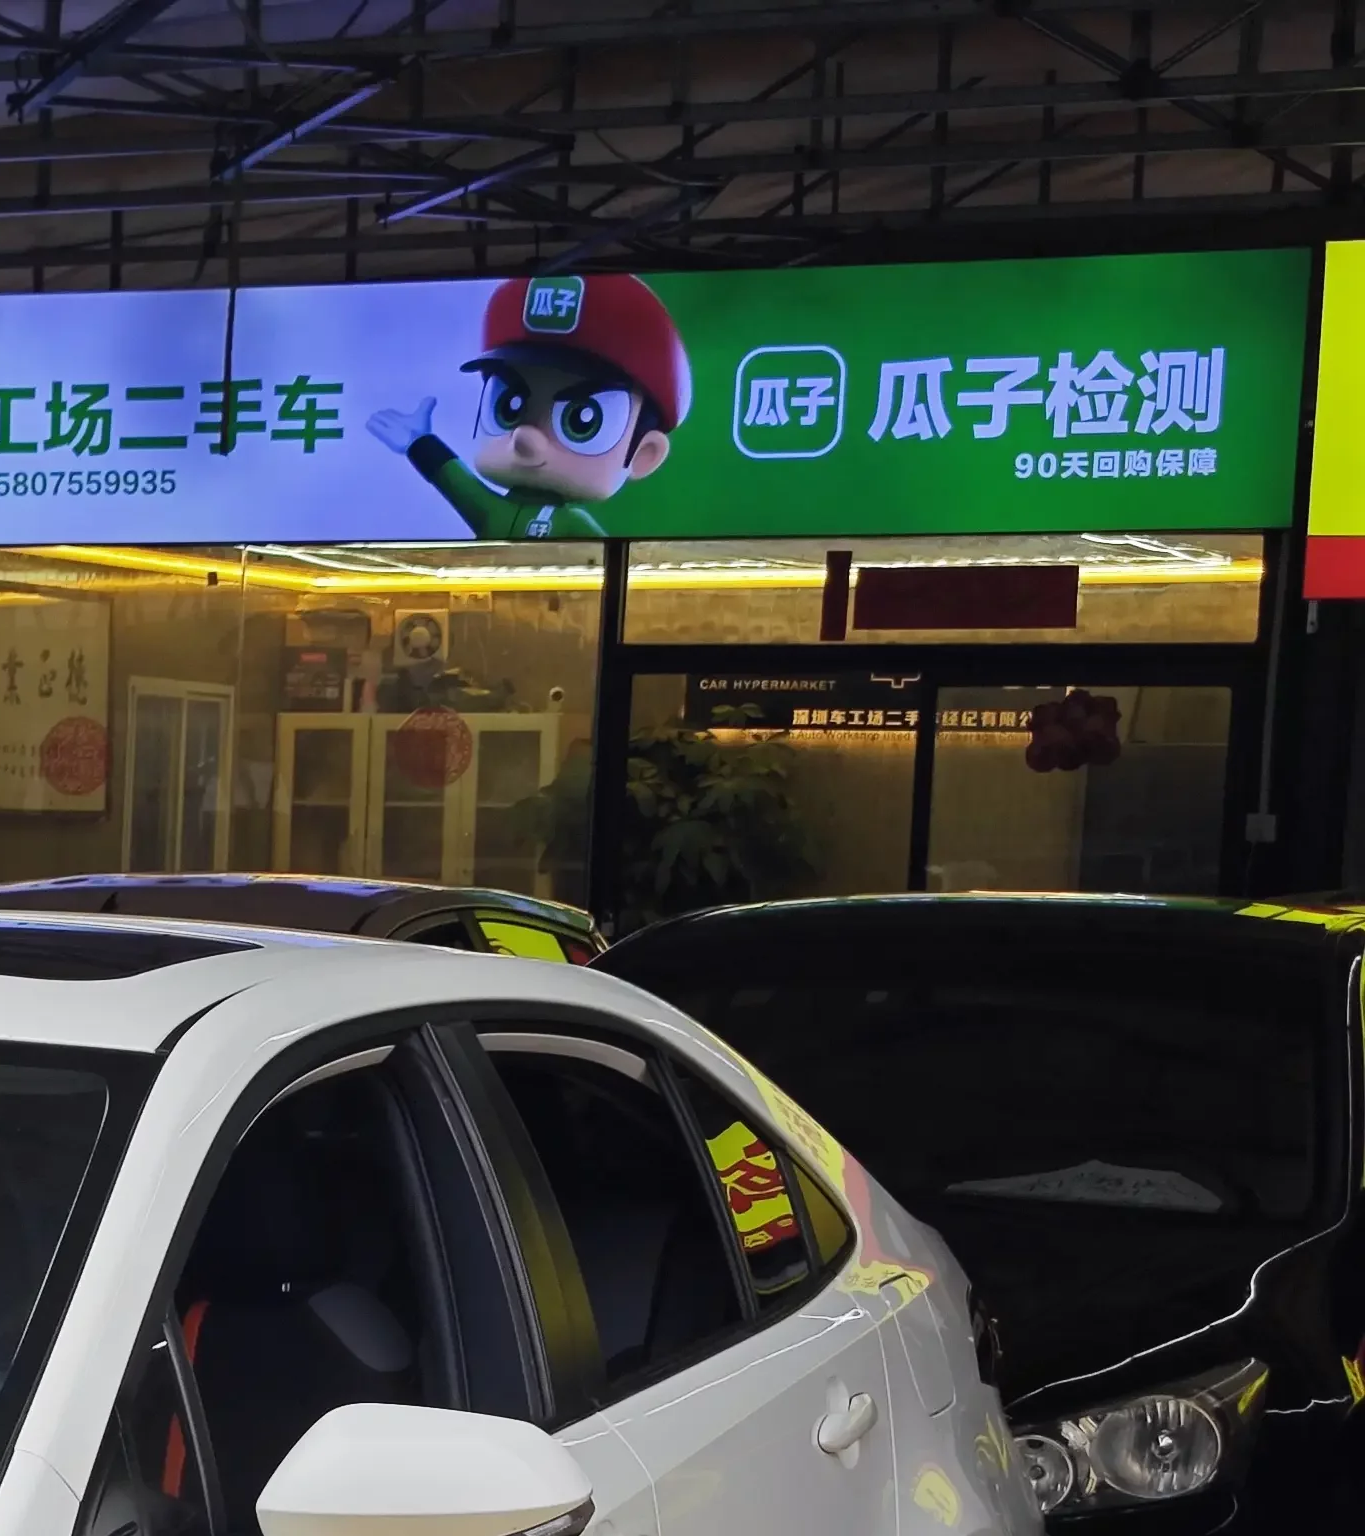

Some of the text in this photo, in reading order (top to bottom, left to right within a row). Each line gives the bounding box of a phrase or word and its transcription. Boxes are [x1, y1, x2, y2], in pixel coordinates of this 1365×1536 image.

[530, 287, 578, 317] 瓜子
[742, 376, 836, 429] 瓜子
[867, 346, 1226, 443] 瓜子检测
[1014, 447, 1219, 480] 90天回购保障
[699, 679, 837, 691] CAR HYPERMARKET
